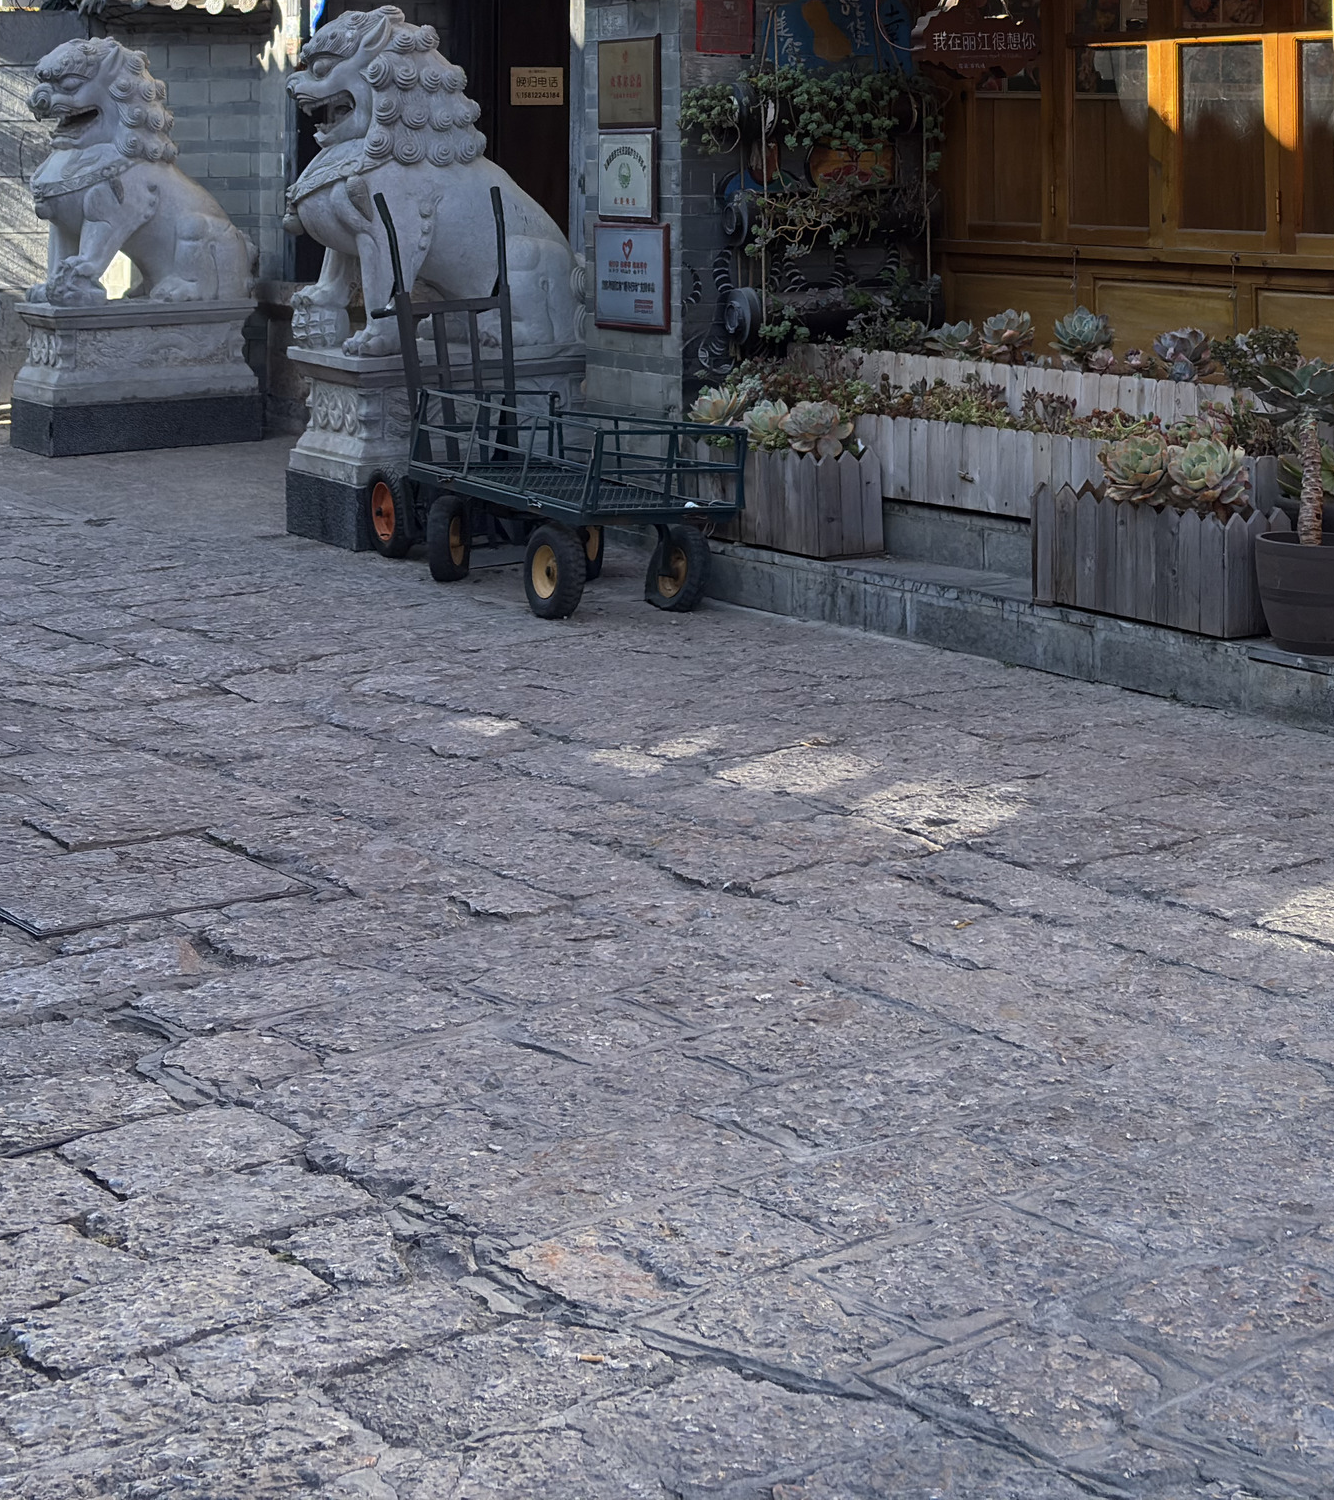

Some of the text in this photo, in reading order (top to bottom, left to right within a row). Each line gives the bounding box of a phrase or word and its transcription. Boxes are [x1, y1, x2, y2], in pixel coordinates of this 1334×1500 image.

[933, 31, 1036, 51] 我在丽江很想你
